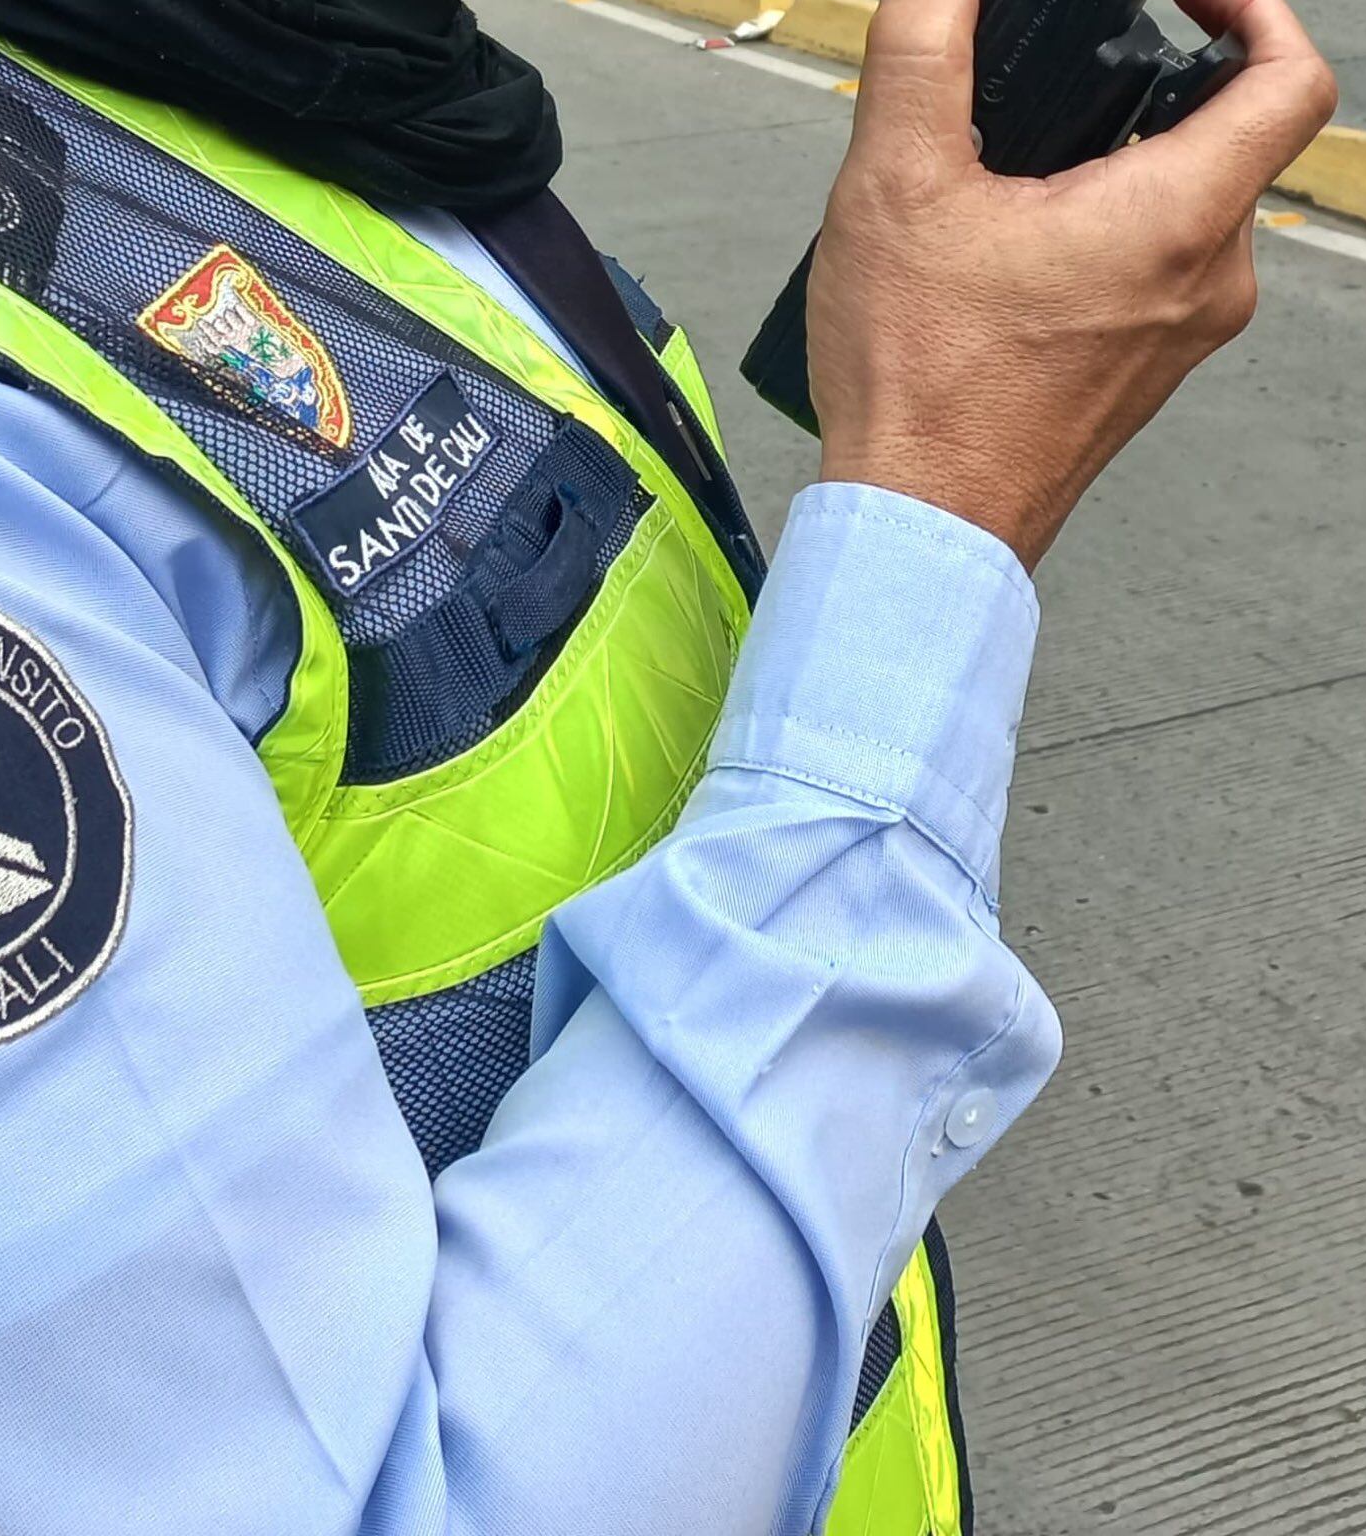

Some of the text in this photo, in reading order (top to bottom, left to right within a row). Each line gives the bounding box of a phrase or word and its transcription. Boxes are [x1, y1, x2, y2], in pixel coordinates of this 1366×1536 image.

[398, 414, 435, 455] DE
[409, 454, 457, 507] DE
[440, 413, 491, 468] CALI
